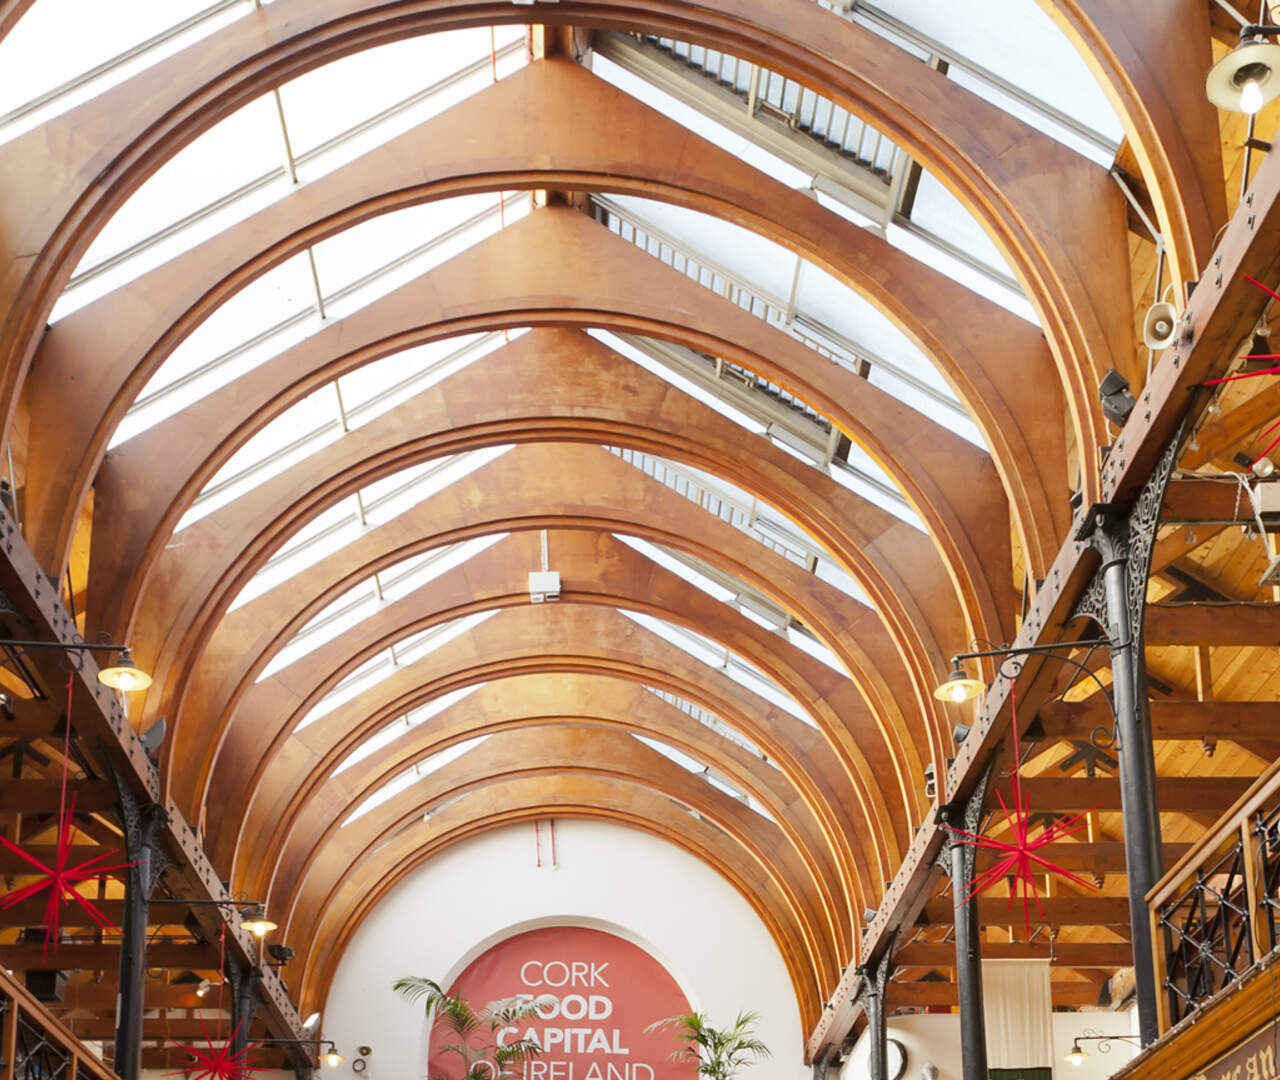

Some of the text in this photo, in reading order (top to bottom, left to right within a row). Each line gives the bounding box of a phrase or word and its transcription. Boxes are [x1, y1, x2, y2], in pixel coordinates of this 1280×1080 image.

[520, 960, 609, 988] CORK
[515, 993, 613, 1020] FOOD
[496, 1027, 629, 1055] CAPITAL
